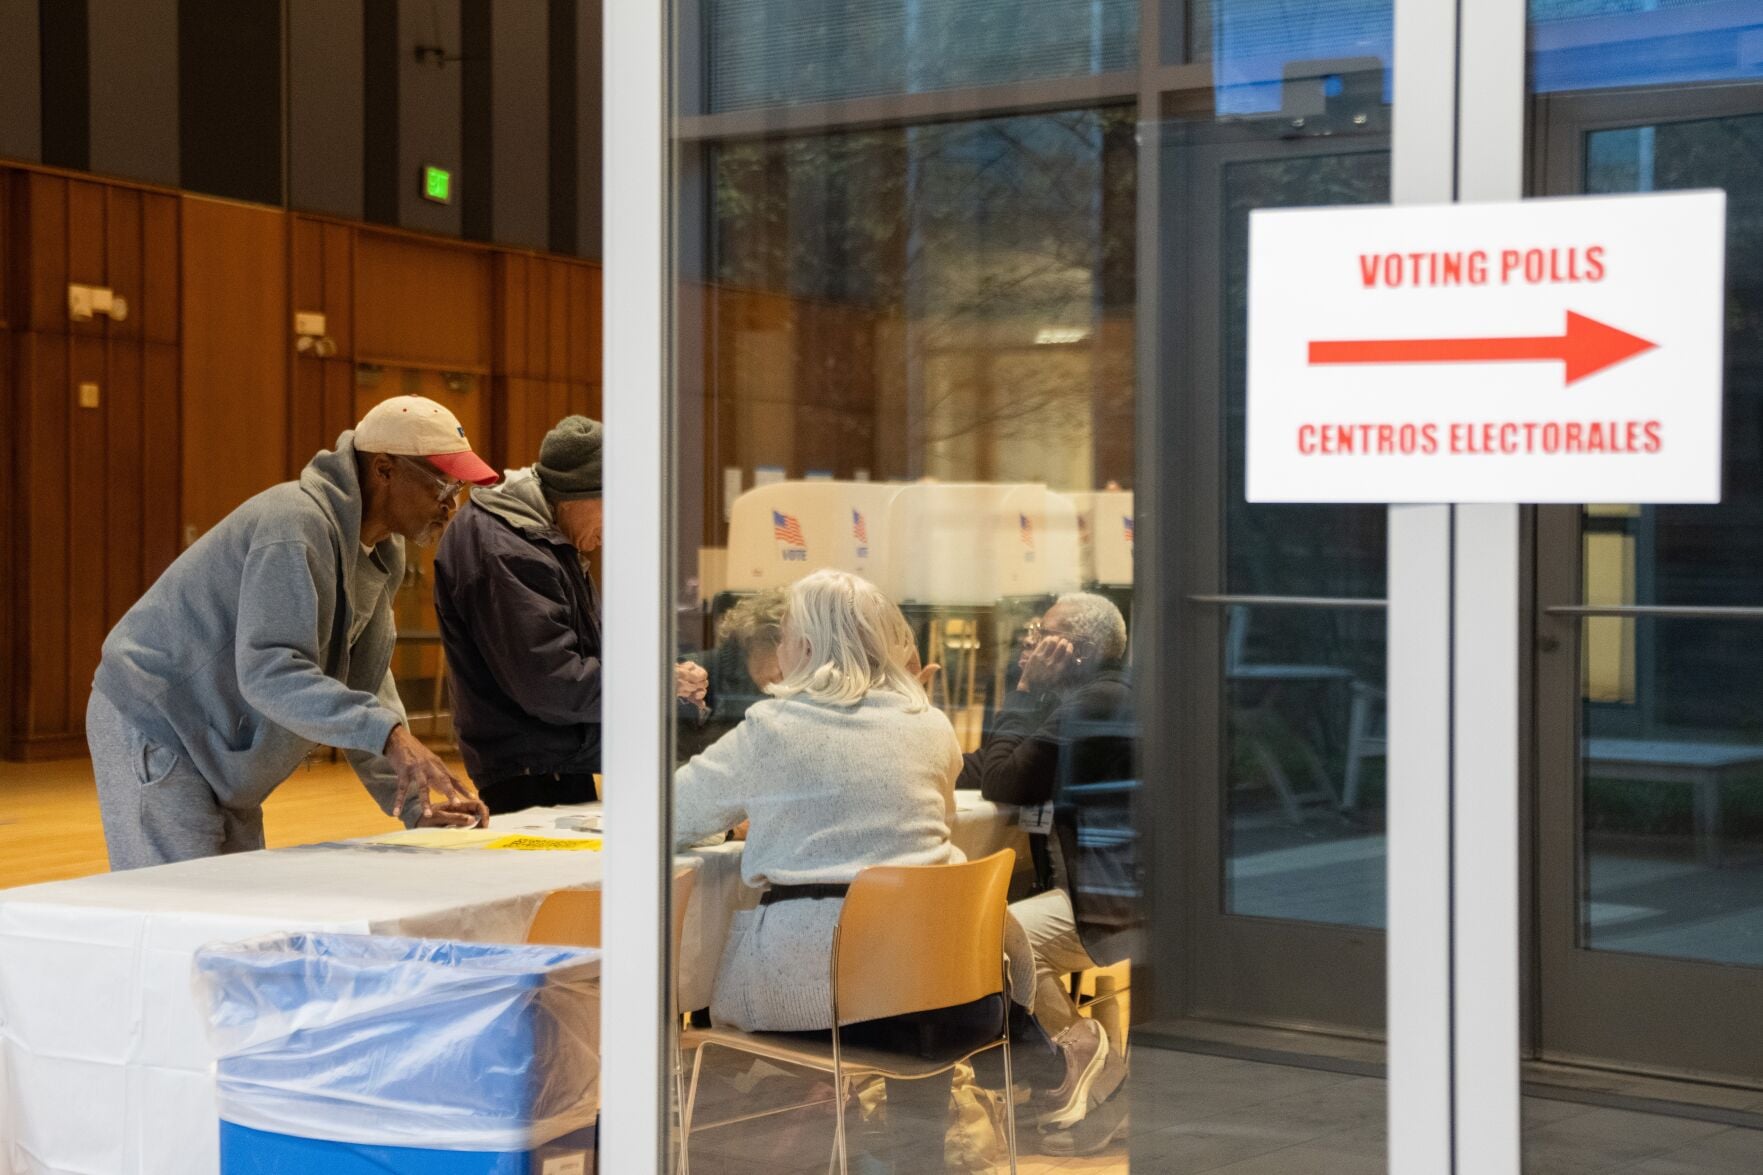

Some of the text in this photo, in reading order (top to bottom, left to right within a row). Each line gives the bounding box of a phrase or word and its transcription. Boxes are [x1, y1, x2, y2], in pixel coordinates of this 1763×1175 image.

[1359, 245, 1606, 288] VOTING POLLS
[1297, 420, 1662, 455] CENTROS ELECTORALES
[782, 549, 807, 562] VOTE
